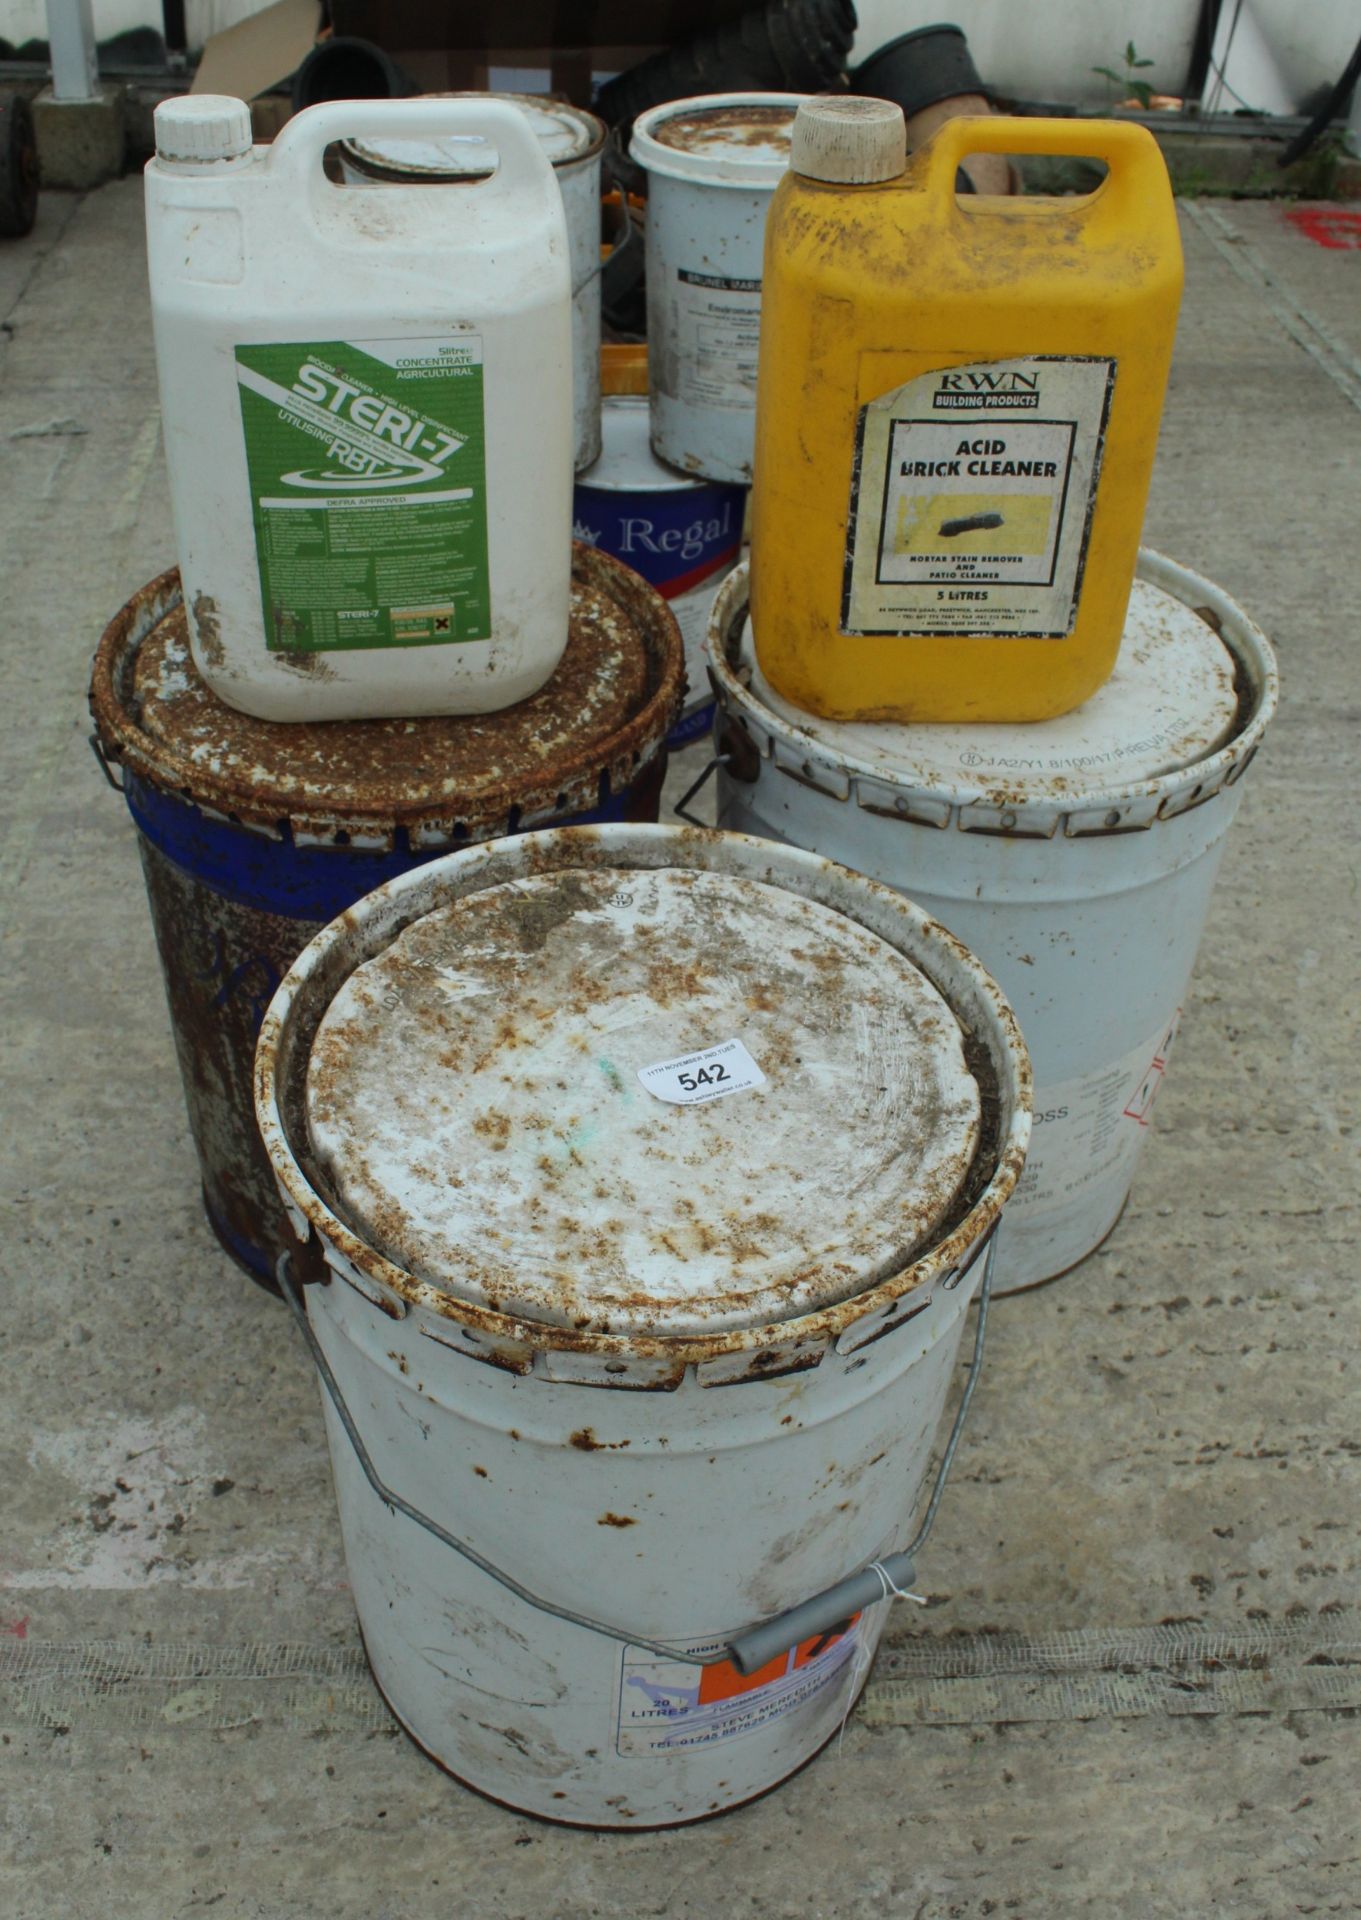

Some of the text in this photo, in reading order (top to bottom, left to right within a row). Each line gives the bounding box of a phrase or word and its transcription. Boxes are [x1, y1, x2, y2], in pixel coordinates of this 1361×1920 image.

[396, 355, 473, 368] CONCENTRATE
[396, 367, 474, 380] AGRICULTURAL
[935, 394, 1037, 407] BUILDING PRODUCTS
[291, 362, 466, 466] STERI-7
[277, 408, 335, 446] UTILISING
[955, 439, 1007, 456] ACID
[966, 460, 1057, 478] CLEANER
[326, 496, 406, 507] DEFRA APPROVED
[618, 501, 731, 560] Regal
[909, 555, 1024, 563] MORTAR STAIN REMOVER
[955, 563, 976, 571] AND
[929, 571, 1000, 579] PATIO CLEANER
[936, 591, 988, 601] 5 LITRES
[337, 610, 380, 619] STERI-7
[647, 1067, 665, 1078] 11TH
[664, 1055, 703, 1072] NOVEMBER
[677, 1063, 731, 1092] 542
[686, 1643, 720, 1655] HIGH
[653, 1699, 671, 1707] 20
[711, 1712, 754, 1732] STEVE
[758, 1675, 823, 1716] MEREDITH
[631, 1707, 689, 1718] LITRES
